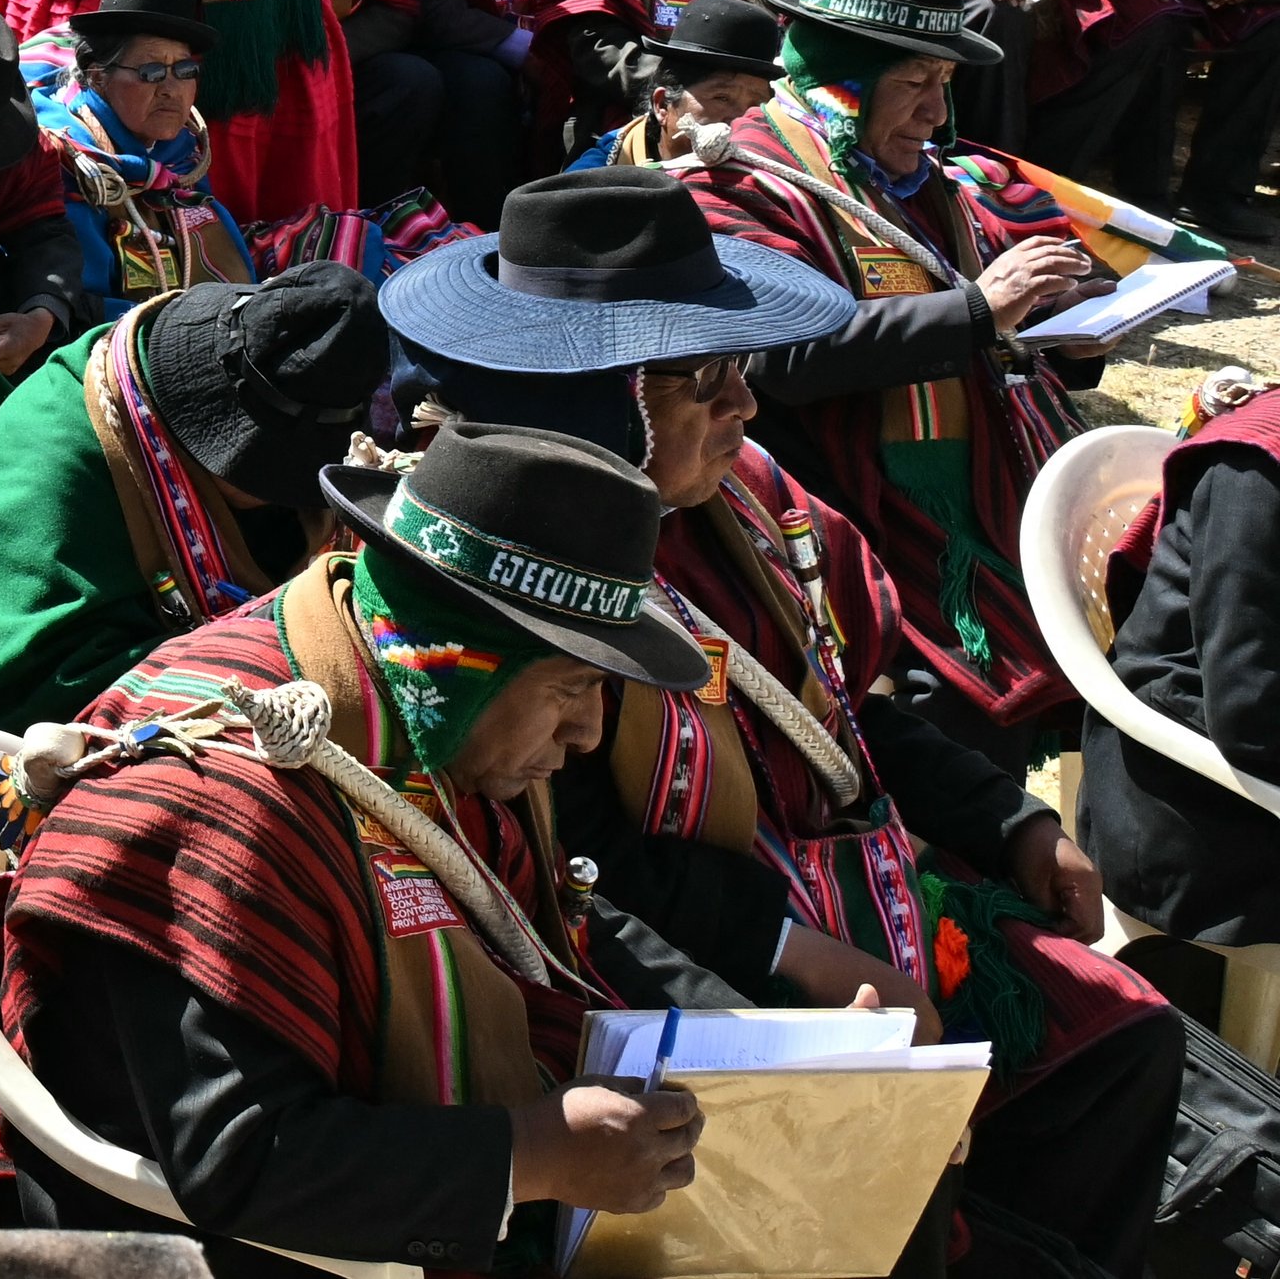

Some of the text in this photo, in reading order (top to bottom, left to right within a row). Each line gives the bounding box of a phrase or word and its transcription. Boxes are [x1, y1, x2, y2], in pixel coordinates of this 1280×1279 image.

[488, 551, 631, 618] EJECUTIVO
[383, 878, 414, 893] ANSELMO
[387, 888, 423, 901] SULLKA
[391, 898, 416, 910] COM.
[392, 904, 438, 919] CONTORNO
[392, 917, 416, 930] PROV.
